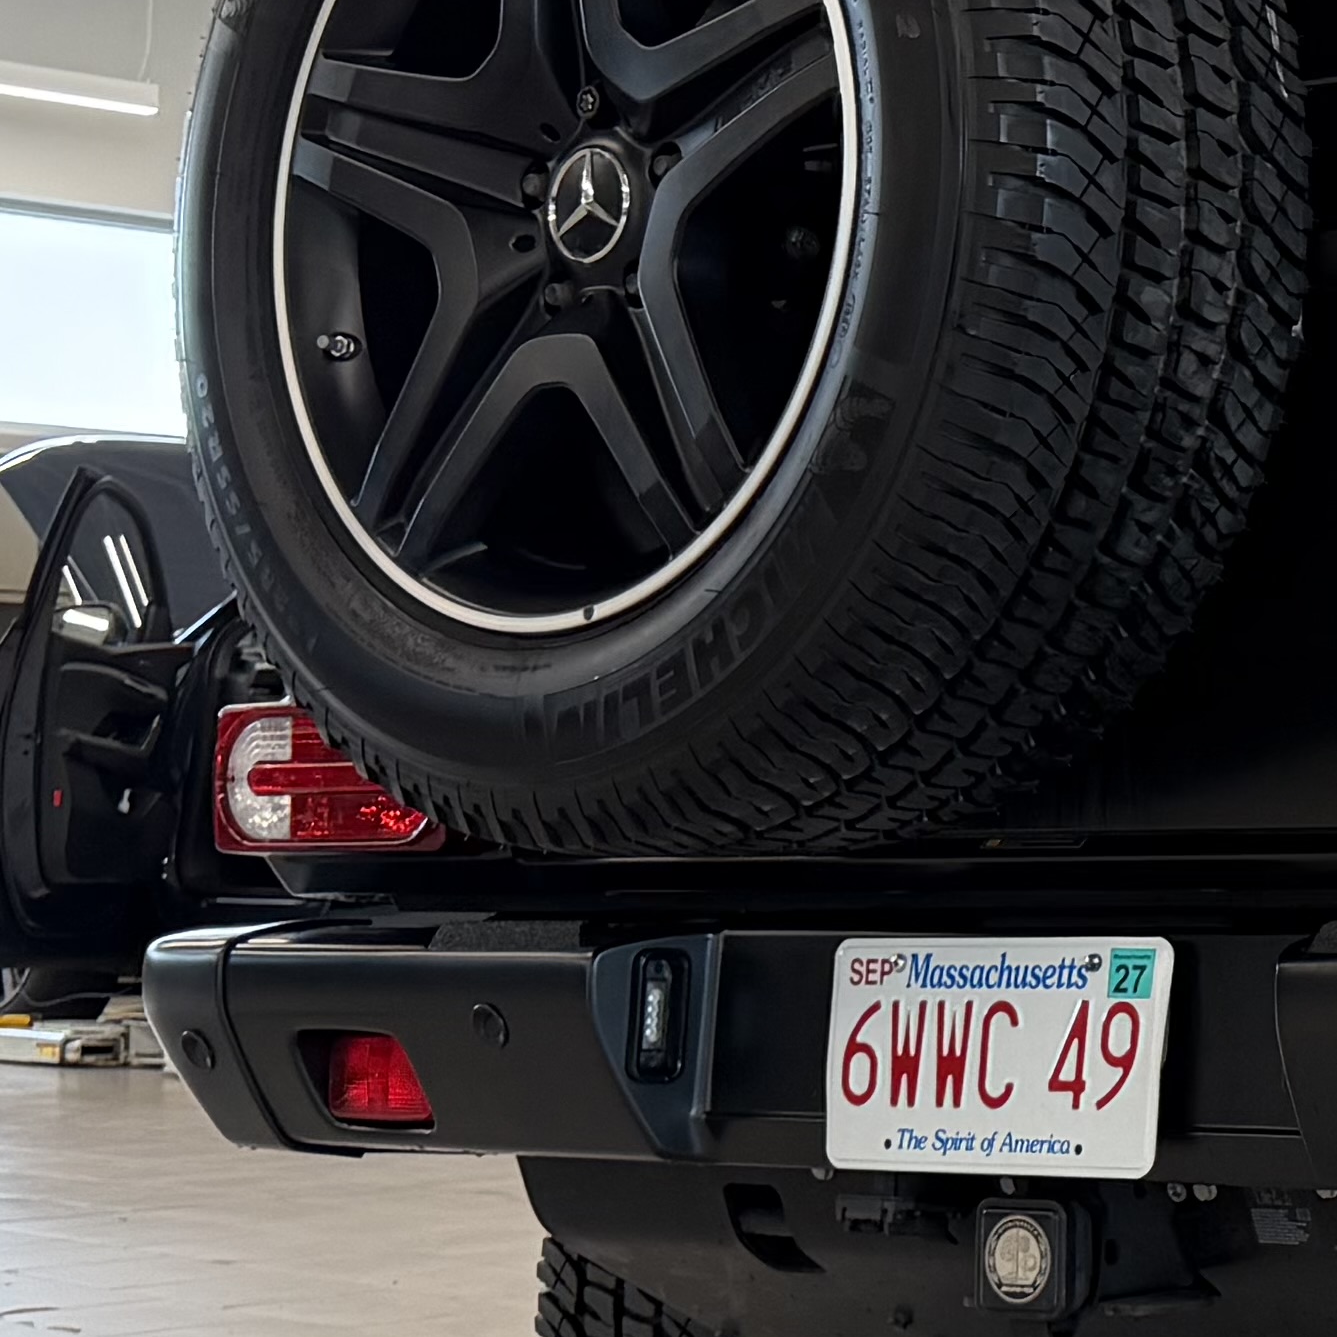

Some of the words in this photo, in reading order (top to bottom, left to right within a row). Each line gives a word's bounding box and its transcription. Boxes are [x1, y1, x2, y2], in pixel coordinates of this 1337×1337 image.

[850, 958, 894, 986] SEP
[906, 952, 1089, 990] Massachusetts
[1112, 963, 1148, 994] 27
[840, 999, 1019, 1111] 6WWC
[1047, 999, 1141, 1111] 49
[896, 1128, 928, 1151] The
[931, 1129, 976, 1157] Spirit
[980, 1130, 998, 1158] of
[999, 1132, 1071, 1156] America
